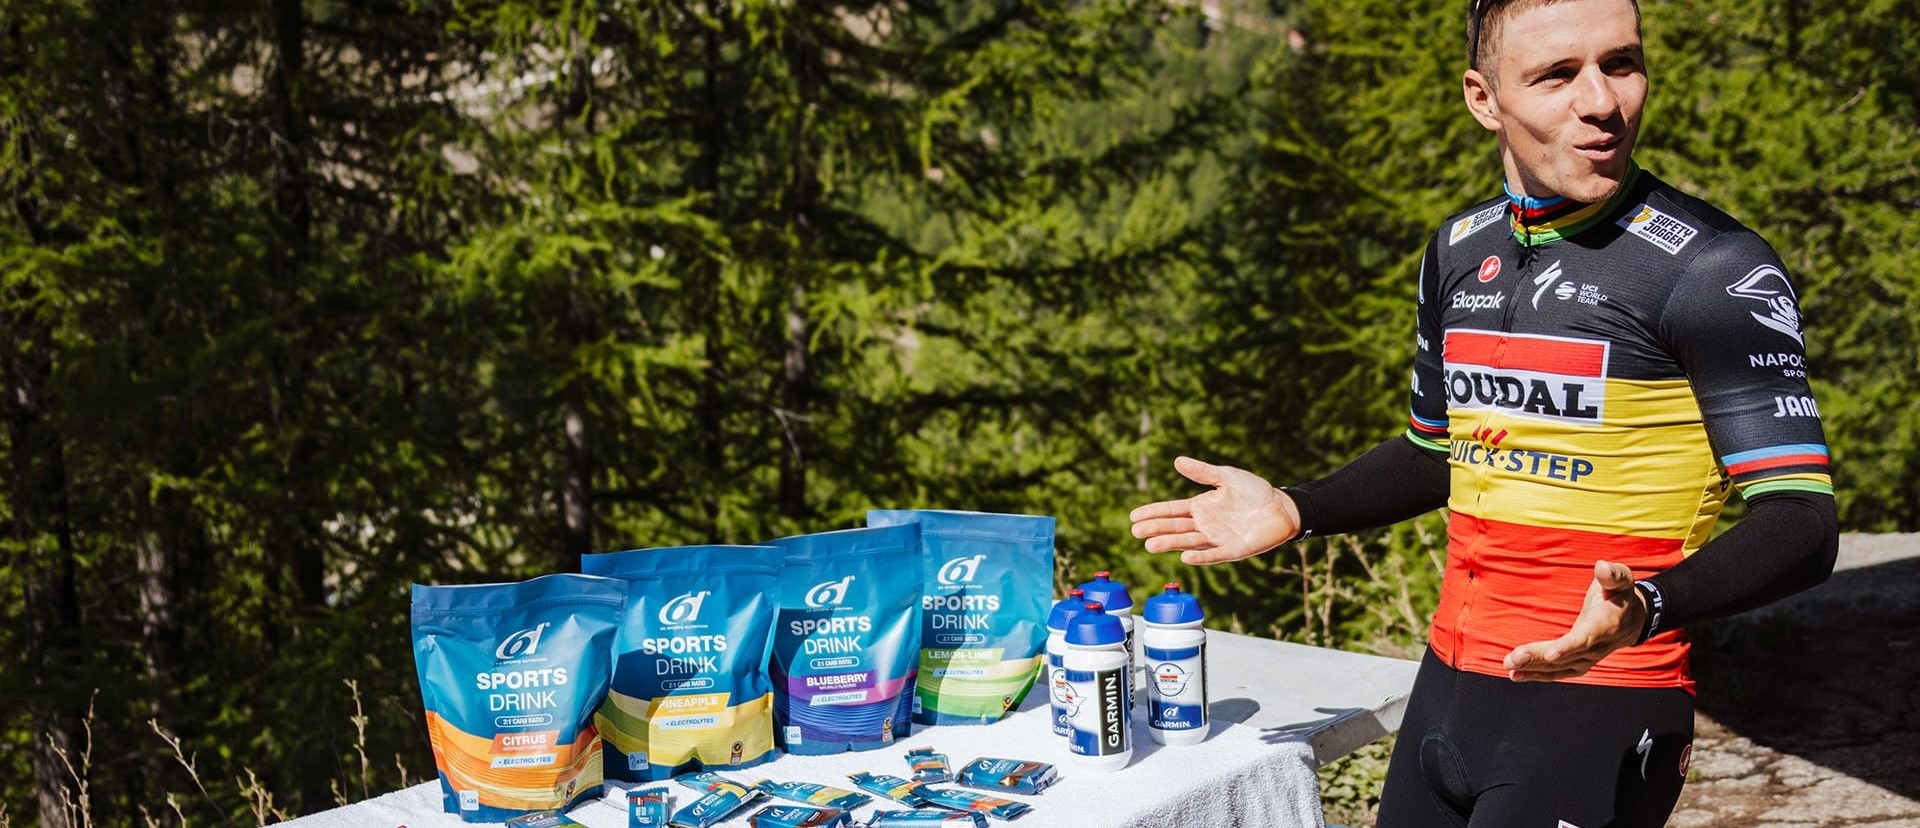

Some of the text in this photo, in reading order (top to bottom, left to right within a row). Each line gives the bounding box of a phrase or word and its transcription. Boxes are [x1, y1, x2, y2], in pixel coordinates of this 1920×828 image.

[1643, 222, 1684, 247] JOGGER
[1653, 215, 1694, 238] SAFETY
[1579, 290, 1608, 301] WORLD
[1581, 283, 1598, 292] UCI
[1452, 290, 1505, 312] Ekopak
[1577, 296, 1598, 306] TEAM
[922, 594, 1000, 612] SPORTS
[790, 616, 872, 635] SPORTS
[932, 614, 990, 630] DRINK
[642, 634, 728, 655] SPORTS
[804, 635, 862, 654] DRINK
[928, 650, 993, 659] LEMON-LIME
[656, 656, 718, 675] DRINK
[476, 667, 568, 690] SPORTS
[806, 673, 868, 687] BLUEBERRY
[490, 690, 557, 711] DRINK
[658, 696, 719, 709] PINEAPPLE
[1105, 673, 1120, 747] GARMIN.
[670, 718, 714, 726] ELECTROLYTES
[502, 734, 546, 746] CITRUS
[503, 756, 552, 765] ELECTROLYTES
